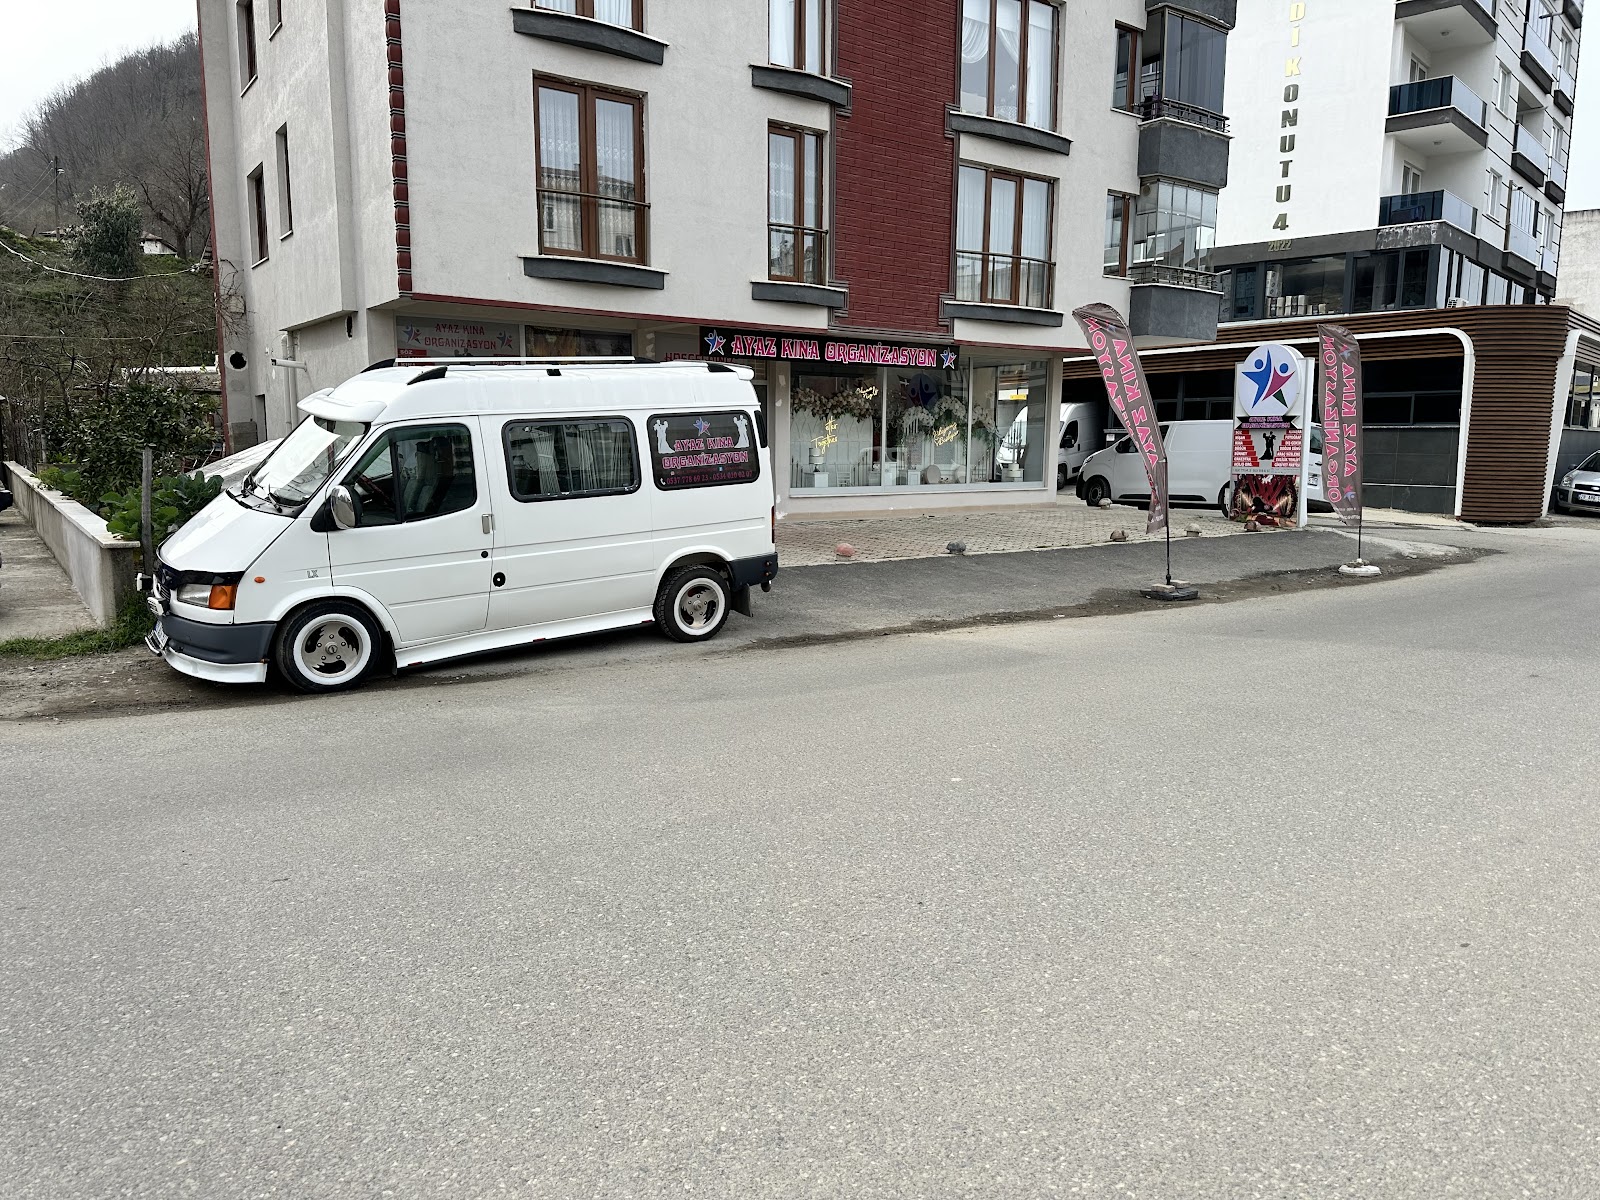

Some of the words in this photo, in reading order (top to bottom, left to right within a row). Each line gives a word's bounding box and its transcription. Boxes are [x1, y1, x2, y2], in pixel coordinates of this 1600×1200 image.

[1267, 239, 1293, 252] 2022
[435, 323, 460, 333] AYAZ
[463, 325, 485, 336] KINA
[424, 336, 497, 350] ORGANİZASYON
[731, 335, 777, 357] AYAZ
[781, 338, 820, 360] KINA
[824, 341, 938, 367] ORGANİZASYON
[674, 438, 705, 452] AYAZ
[706, 436, 734, 449] KINA
[662, 451, 749, 469] ORGANİZASYON
